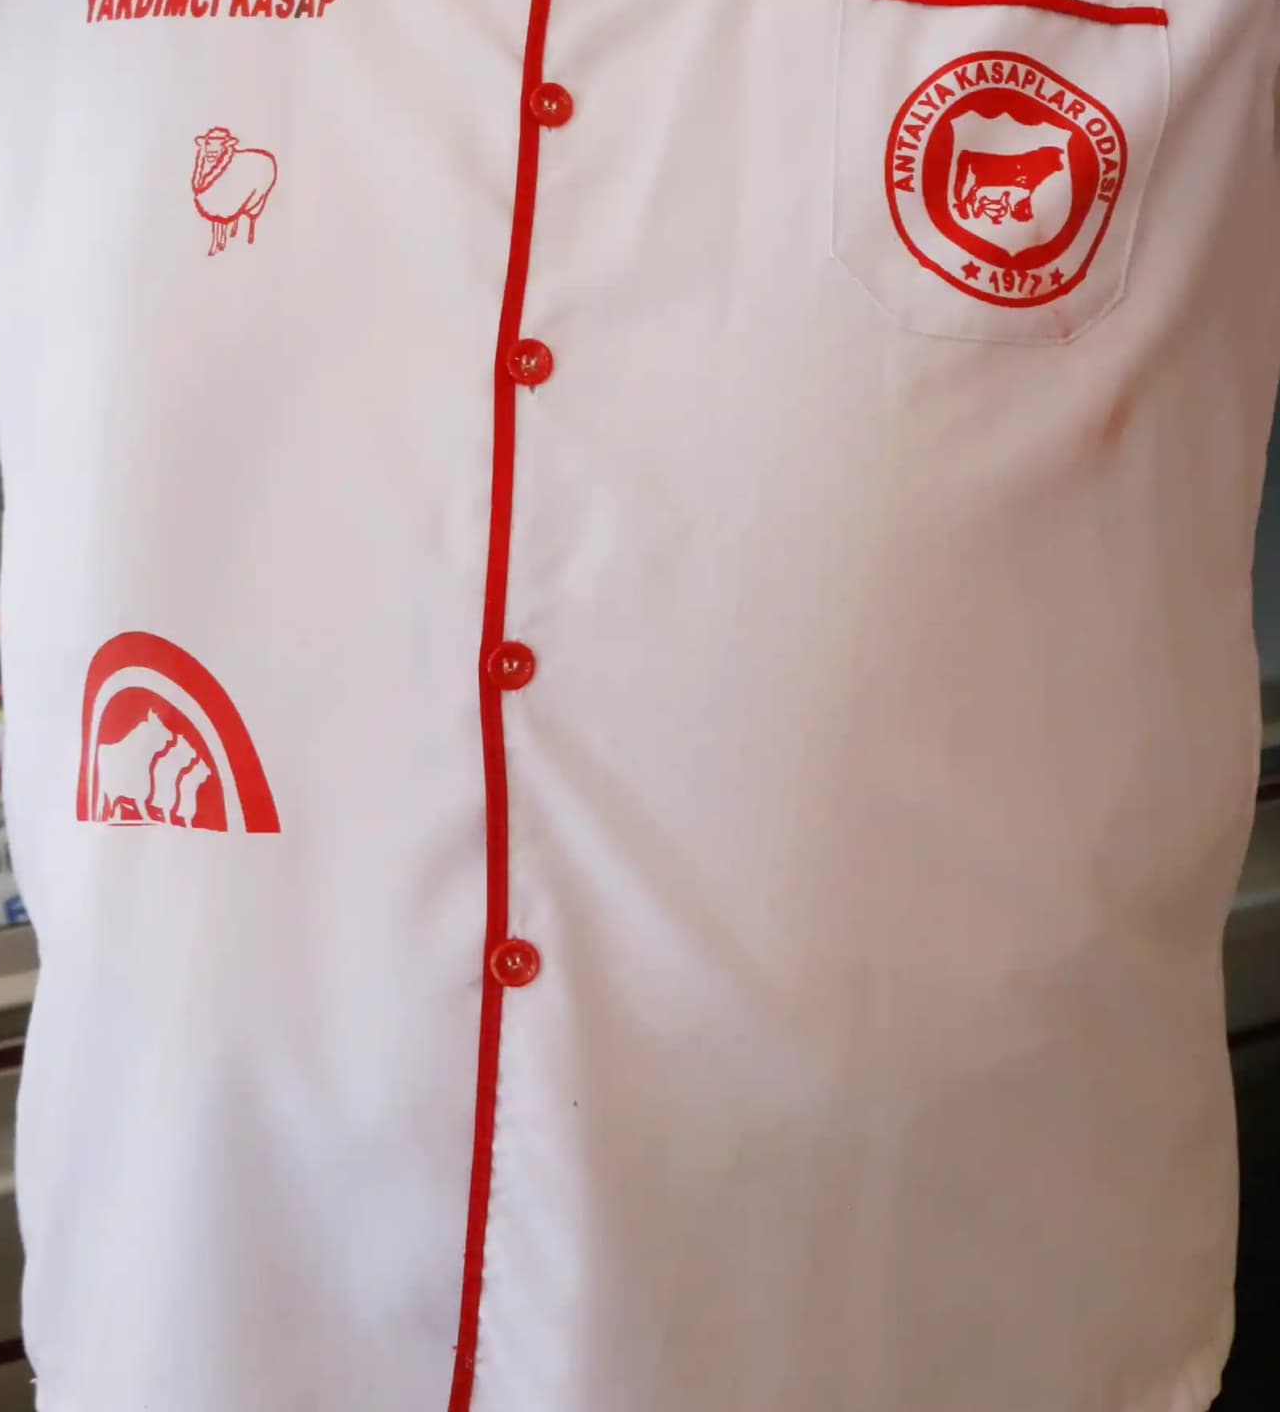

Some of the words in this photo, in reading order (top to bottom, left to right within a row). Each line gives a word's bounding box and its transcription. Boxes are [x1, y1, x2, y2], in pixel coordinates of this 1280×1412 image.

[893, 81, 956, 193] ANTALYA
[952, 60, 1087, 120] KASAPLAR
[1084, 116, 1121, 204] ODASI
[987, 269, 1044, 297] 1977
